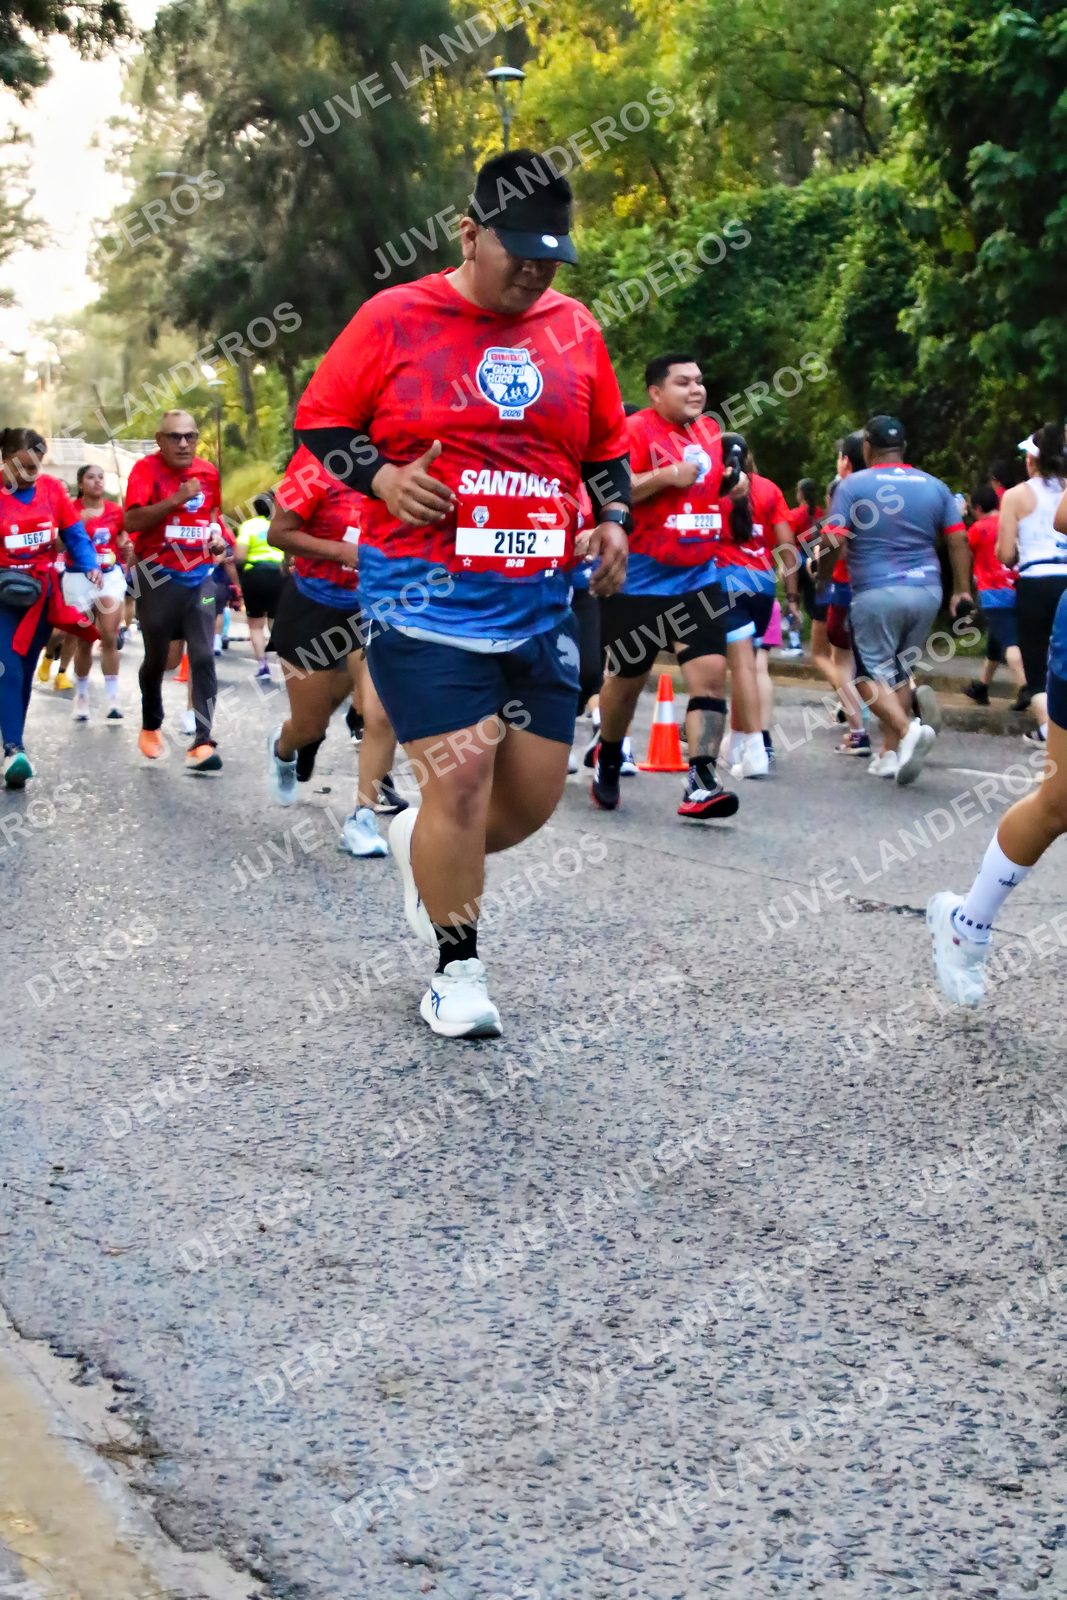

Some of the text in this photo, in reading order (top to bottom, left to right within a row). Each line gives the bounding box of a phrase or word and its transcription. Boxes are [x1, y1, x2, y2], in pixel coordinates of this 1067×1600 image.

[493, 365, 525, 375] Global
[487, 374, 513, 383] Race
[181, 528, 201, 537] 2265
[23, 532, 43, 544] 1562
[494, 531, 537, 554] 2152
